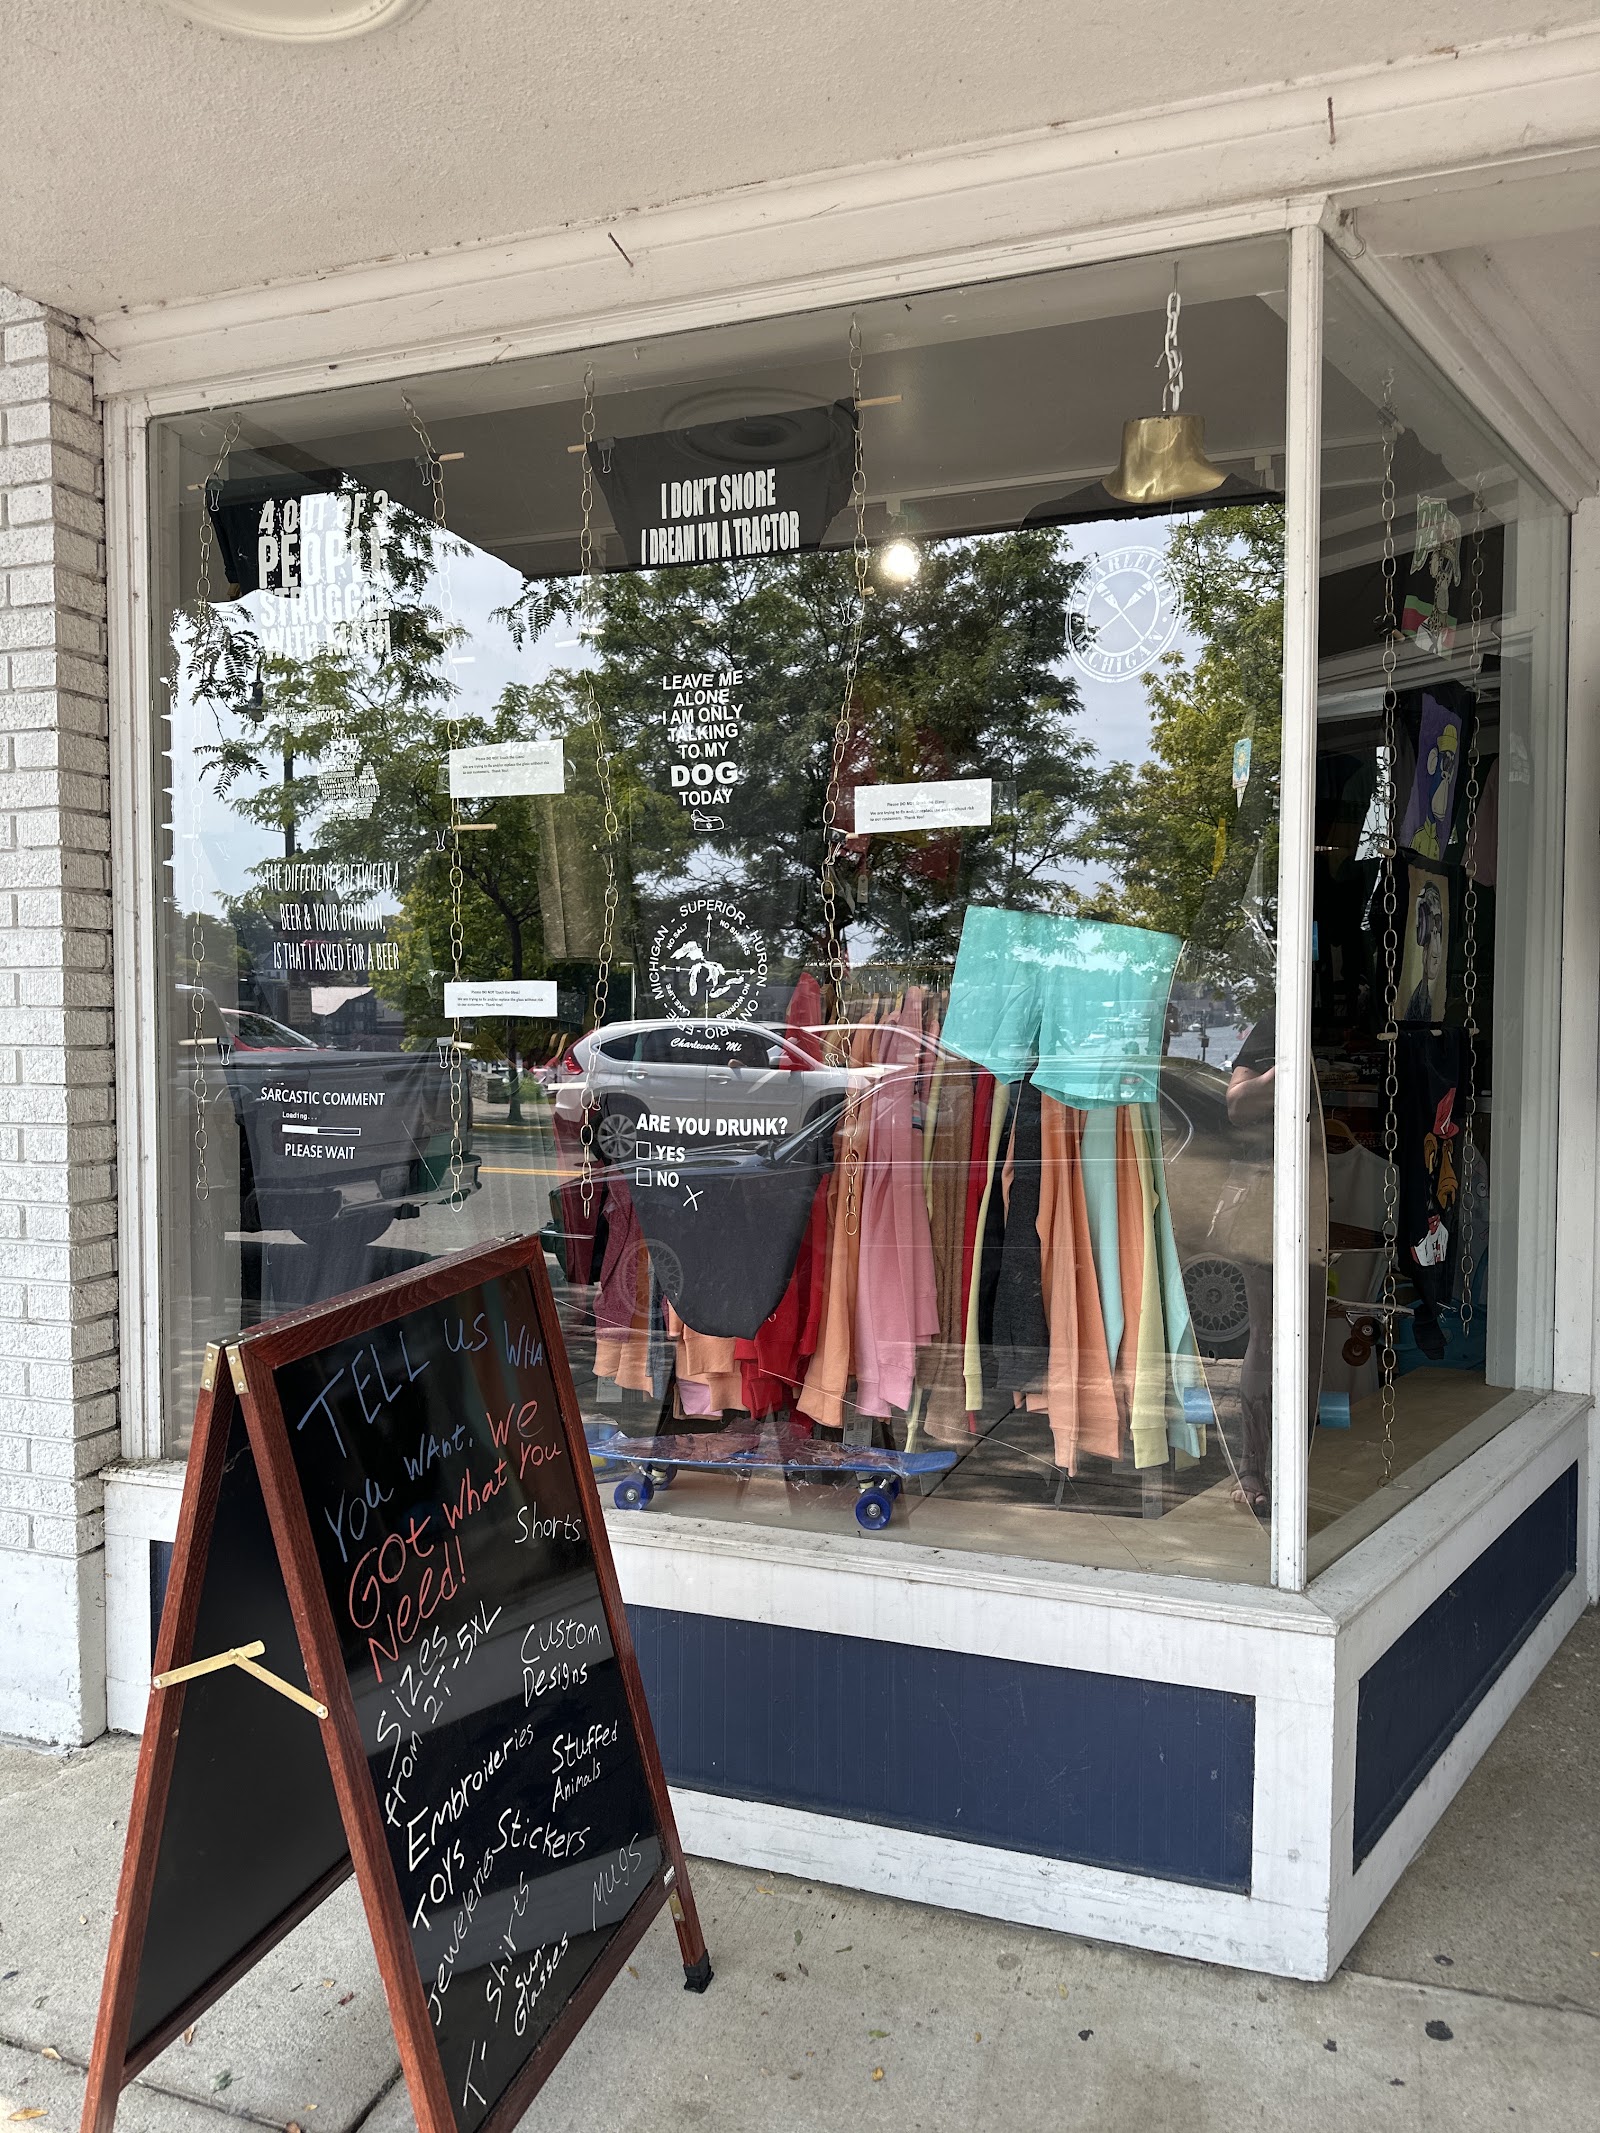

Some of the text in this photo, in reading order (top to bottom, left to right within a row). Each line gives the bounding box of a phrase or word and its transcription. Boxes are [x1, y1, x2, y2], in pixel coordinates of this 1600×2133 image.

[661, 468, 776, 519] I DON'T SNORE
[259, 500, 275, 535] 4
[641, 511, 800, 565] I DREAM I'M A TRACTOR
[662, 669, 744, 691] LEAVE ME
[673, 688, 730, 706] ALONE
[662, 704, 744, 725] I AM ONLY
[667, 723, 739, 743] TALKING
[678, 741, 728, 760] TO MY
[670, 762, 738, 787] DOG
[679, 788, 733, 806] TODAY
[265, 861, 400, 891] THE DIFFERENCE BETWEEN A
[280, 902, 386, 934] BEER & YOUR OPINION,
[679, 899, 746, 925] SUPERIOR
[666, 922, 689, 951] NO SALT
[719, 919, 751, 957] NO SHARKS
[273, 941, 400, 971] IS THAT I ASKED FOR A BEER
[649, 924, 669, 1001] MICHIGAN
[750, 929, 768, 988] HURON
[665, 982, 691, 1017] LAKE LIFE
[742, 982, 751, 996] NO
[705, 999, 759, 1039] ONTARIO
[716, 994, 746, 1020] WORRIES
[666, 1009, 695, 1036] ERIE
[670, 1037, 721, 1051] Charlevoix,
[261, 1087, 386, 1106] SARCASTIC COMMENT
[636, 1113, 789, 1136] ARE YOU DRUNK?
[284, 1143, 356, 1160] PLEASE WAIT
[656, 1144, 686, 1163] YES
[656, 1171, 680, 1188] NO
[296, 1330, 430, 1459] TELL
[514, 1500, 582, 1545] Shorts
[523, 1662, 588, 1708] Designs
[551, 1719, 619, 1775] Stuffed
[552, 1756, 602, 1813] Animals
[492, 1807, 591, 1859] Stickers
